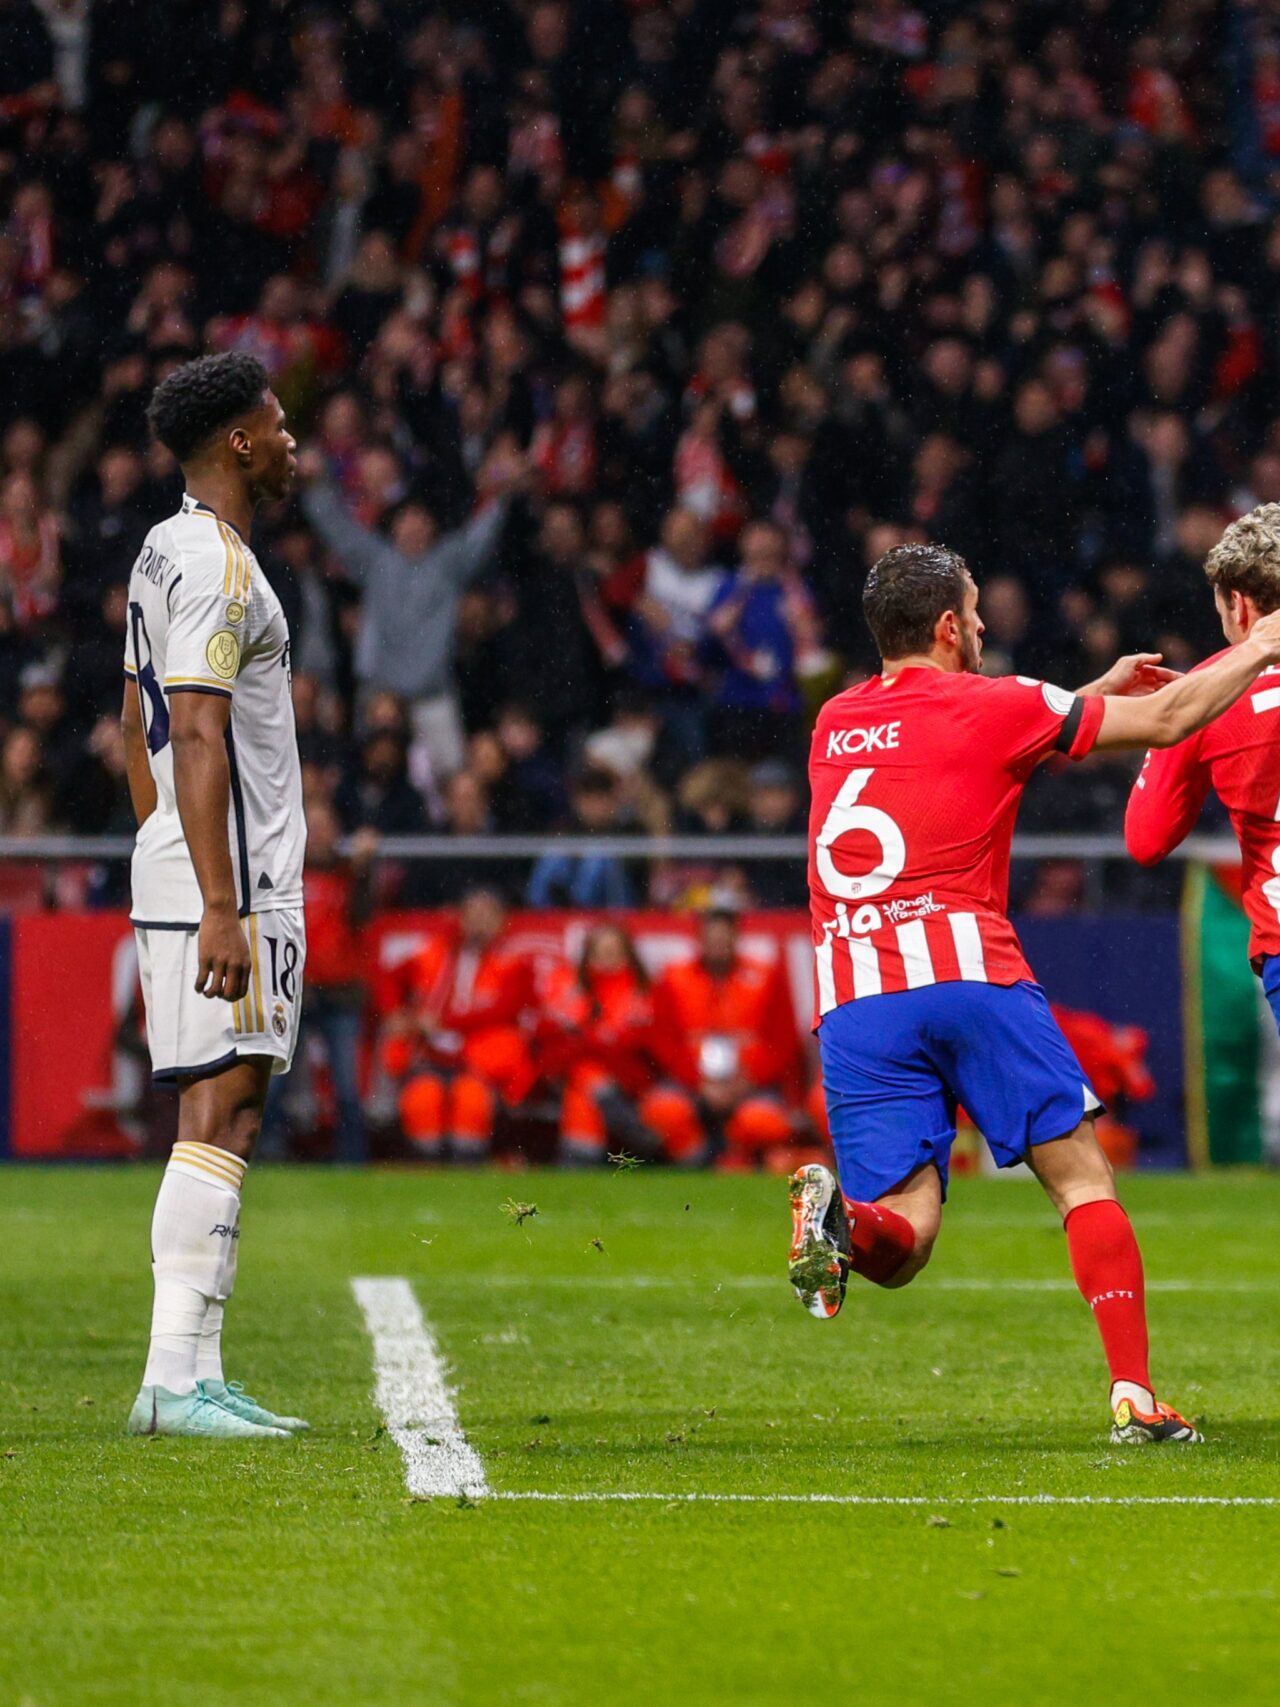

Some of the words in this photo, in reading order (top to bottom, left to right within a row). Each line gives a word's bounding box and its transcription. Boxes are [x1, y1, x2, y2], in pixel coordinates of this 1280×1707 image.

[228, 608, 240, 617] 20
[826, 721, 902, 759] KOKE
[816, 767, 906, 900] 6
[882, 891, 933, 912] Money
[263, 935, 297, 1004] 18
